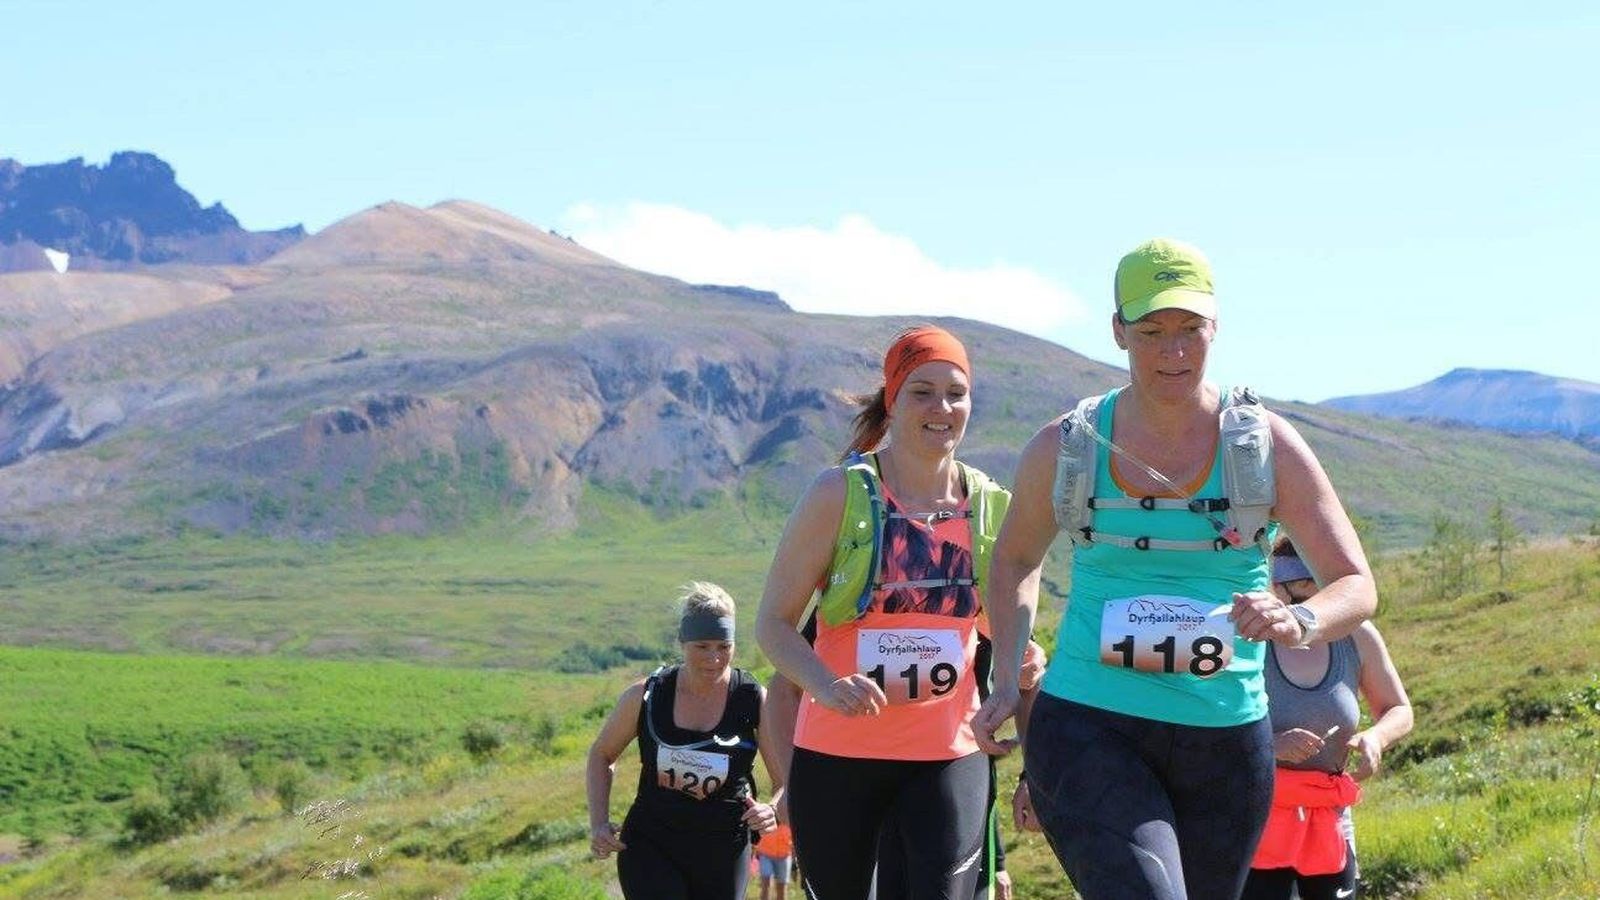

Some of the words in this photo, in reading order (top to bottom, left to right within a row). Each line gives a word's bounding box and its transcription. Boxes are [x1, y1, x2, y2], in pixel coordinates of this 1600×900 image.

[1128, 613, 1206, 625] Dyrfjallahlaup
[1112, 635, 1223, 678] 118
[867, 662, 958, 699] 119
[664, 768, 721, 798] 120
